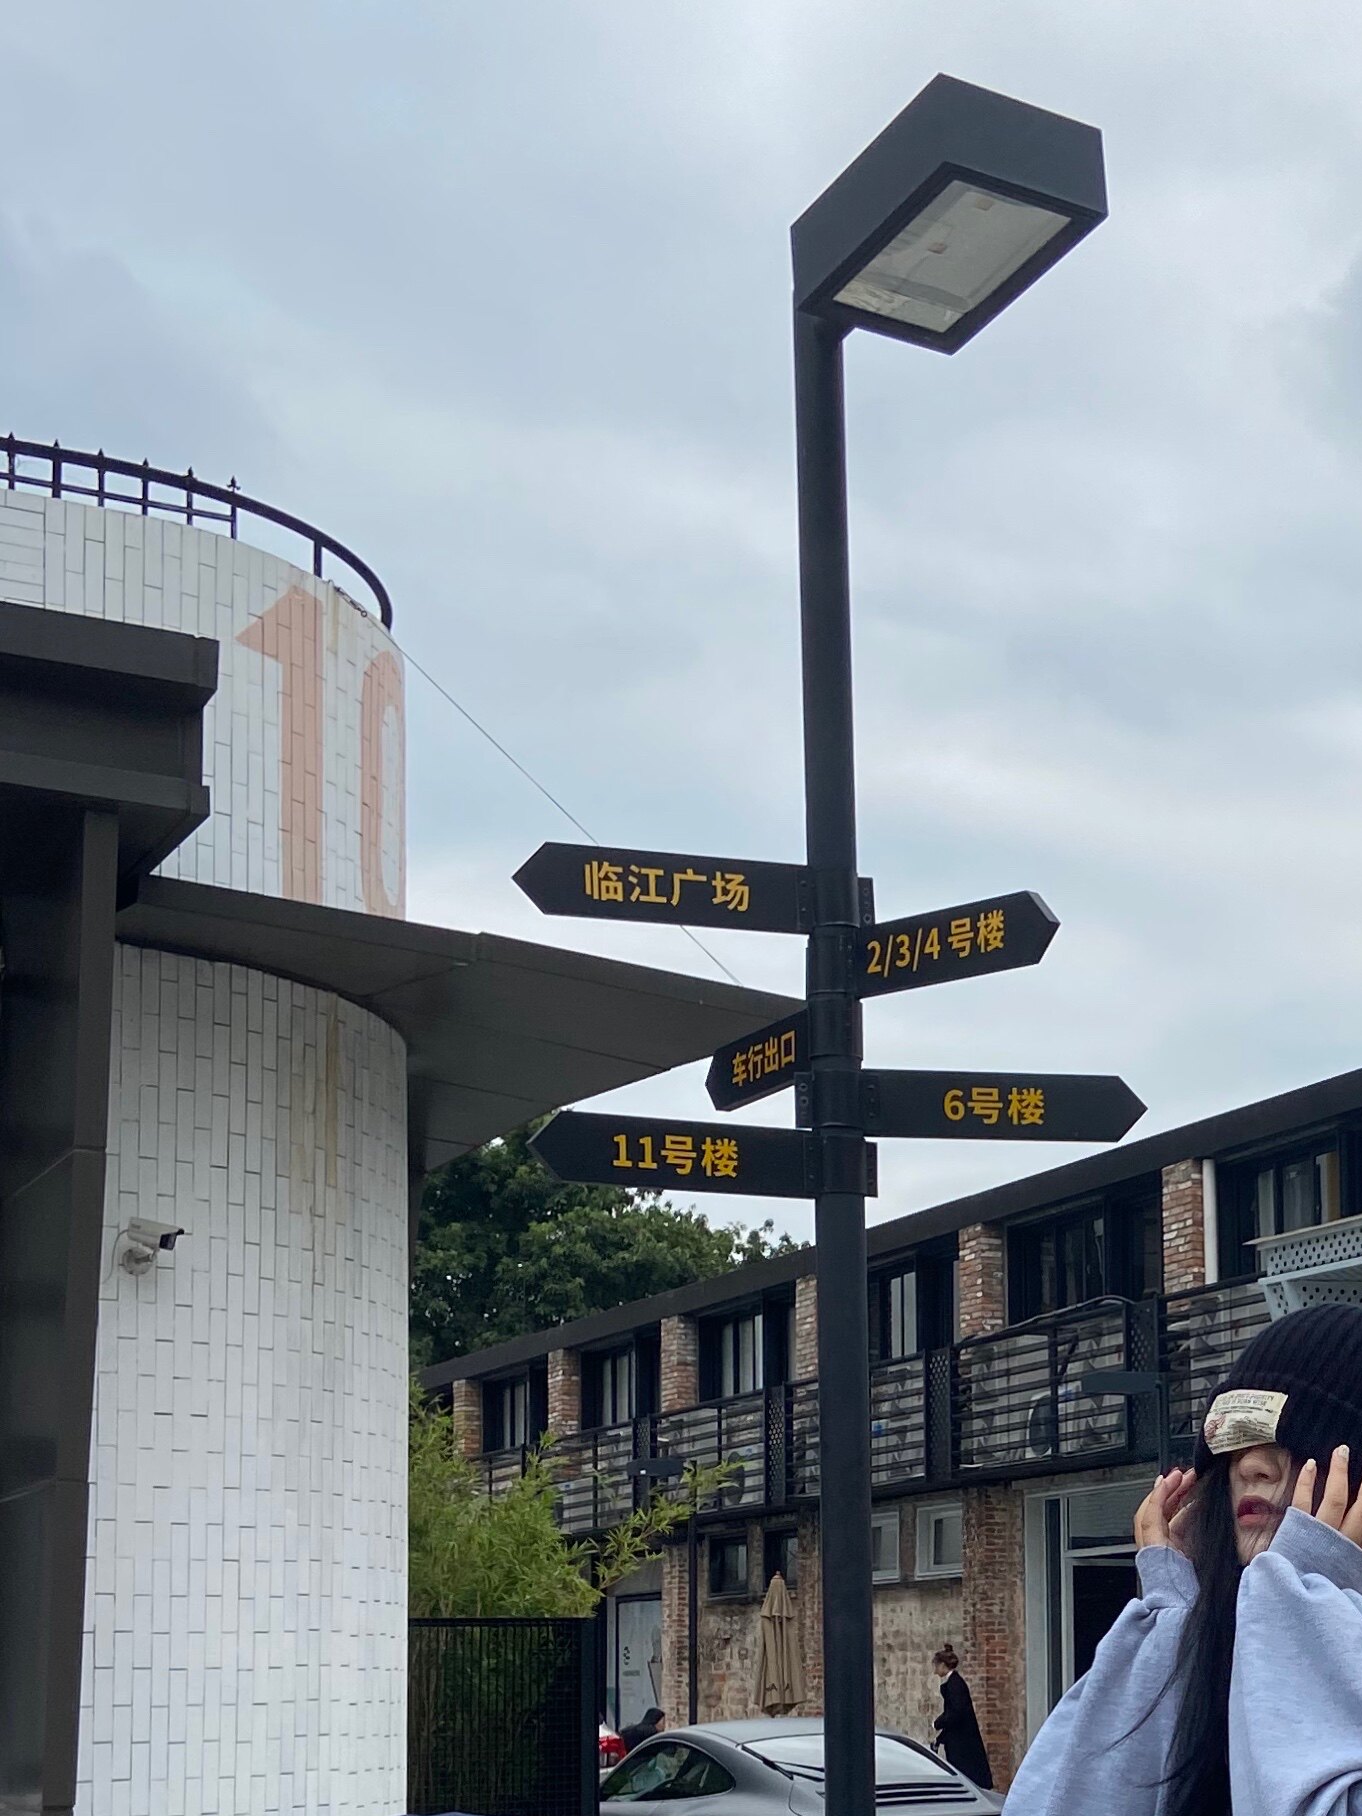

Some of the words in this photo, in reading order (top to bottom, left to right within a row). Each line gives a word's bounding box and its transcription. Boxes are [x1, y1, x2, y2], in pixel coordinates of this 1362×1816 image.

[584, 860, 750, 913] 临江广场
[731, 1029, 796, 1087] 车行出口
[943, 1087, 1045, 1125] 6号楼
[612, 1134, 739, 1178] 11号楼
